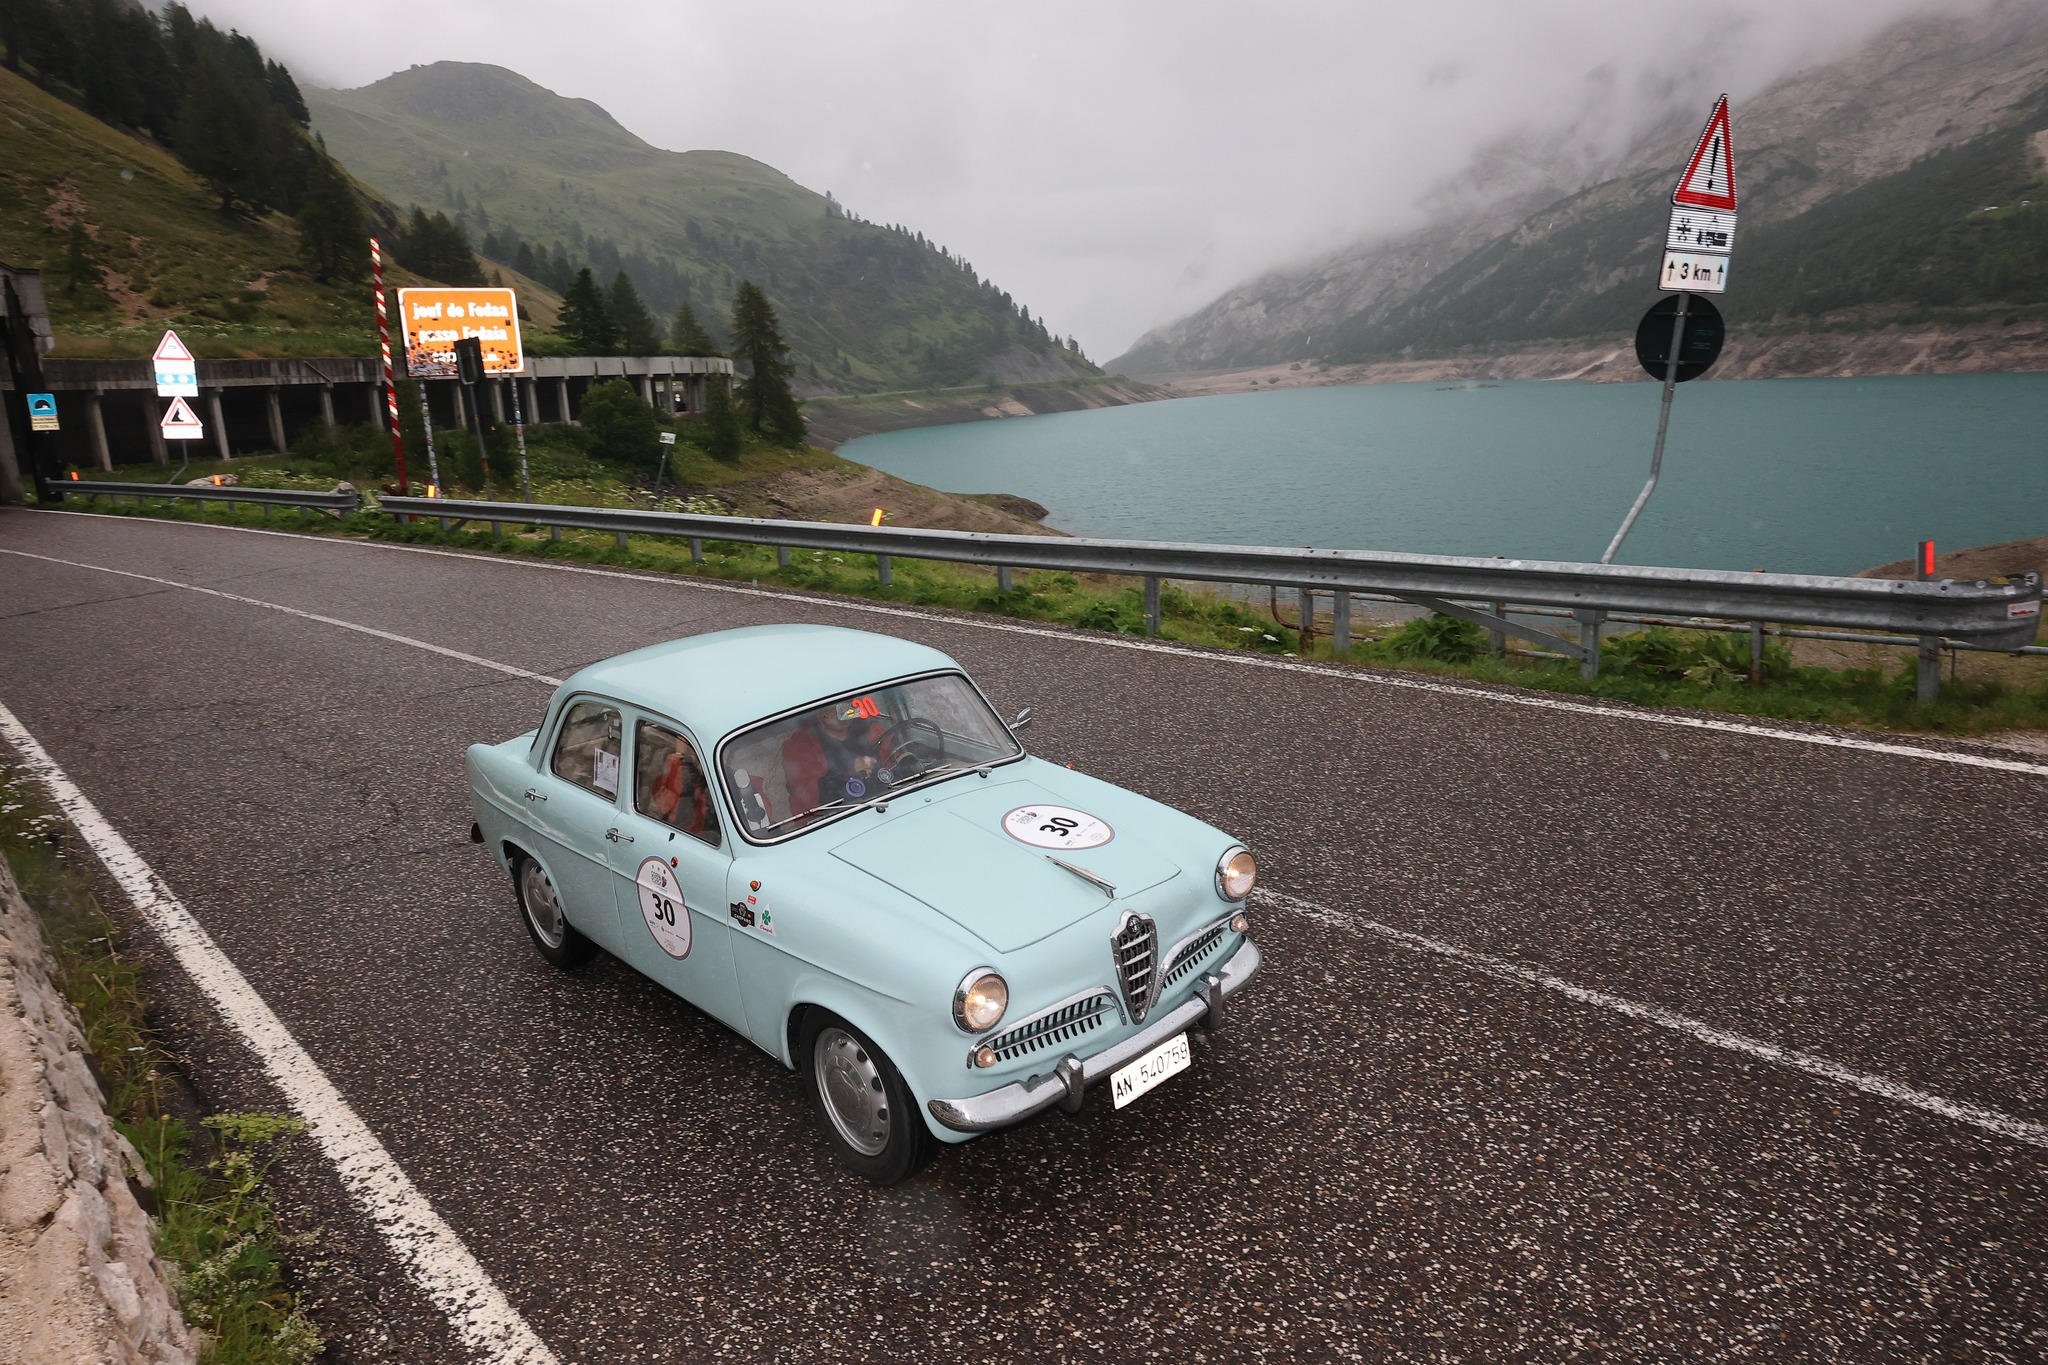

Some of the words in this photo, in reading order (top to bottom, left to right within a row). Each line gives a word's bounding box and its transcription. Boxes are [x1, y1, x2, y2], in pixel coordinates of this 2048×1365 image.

[1680, 262, 1689, 280] 3
[1692, 263, 1711, 281] km
[412, 302, 442, 320] jouf
[446, 302, 465, 318] de
[851, 696, 879, 719] 30
[1039, 817, 1079, 837] 30
[652, 893, 675, 926] 30
[1116, 1074, 1133, 1100] AN
[1140, 1041, 1188, 1083] 540759
